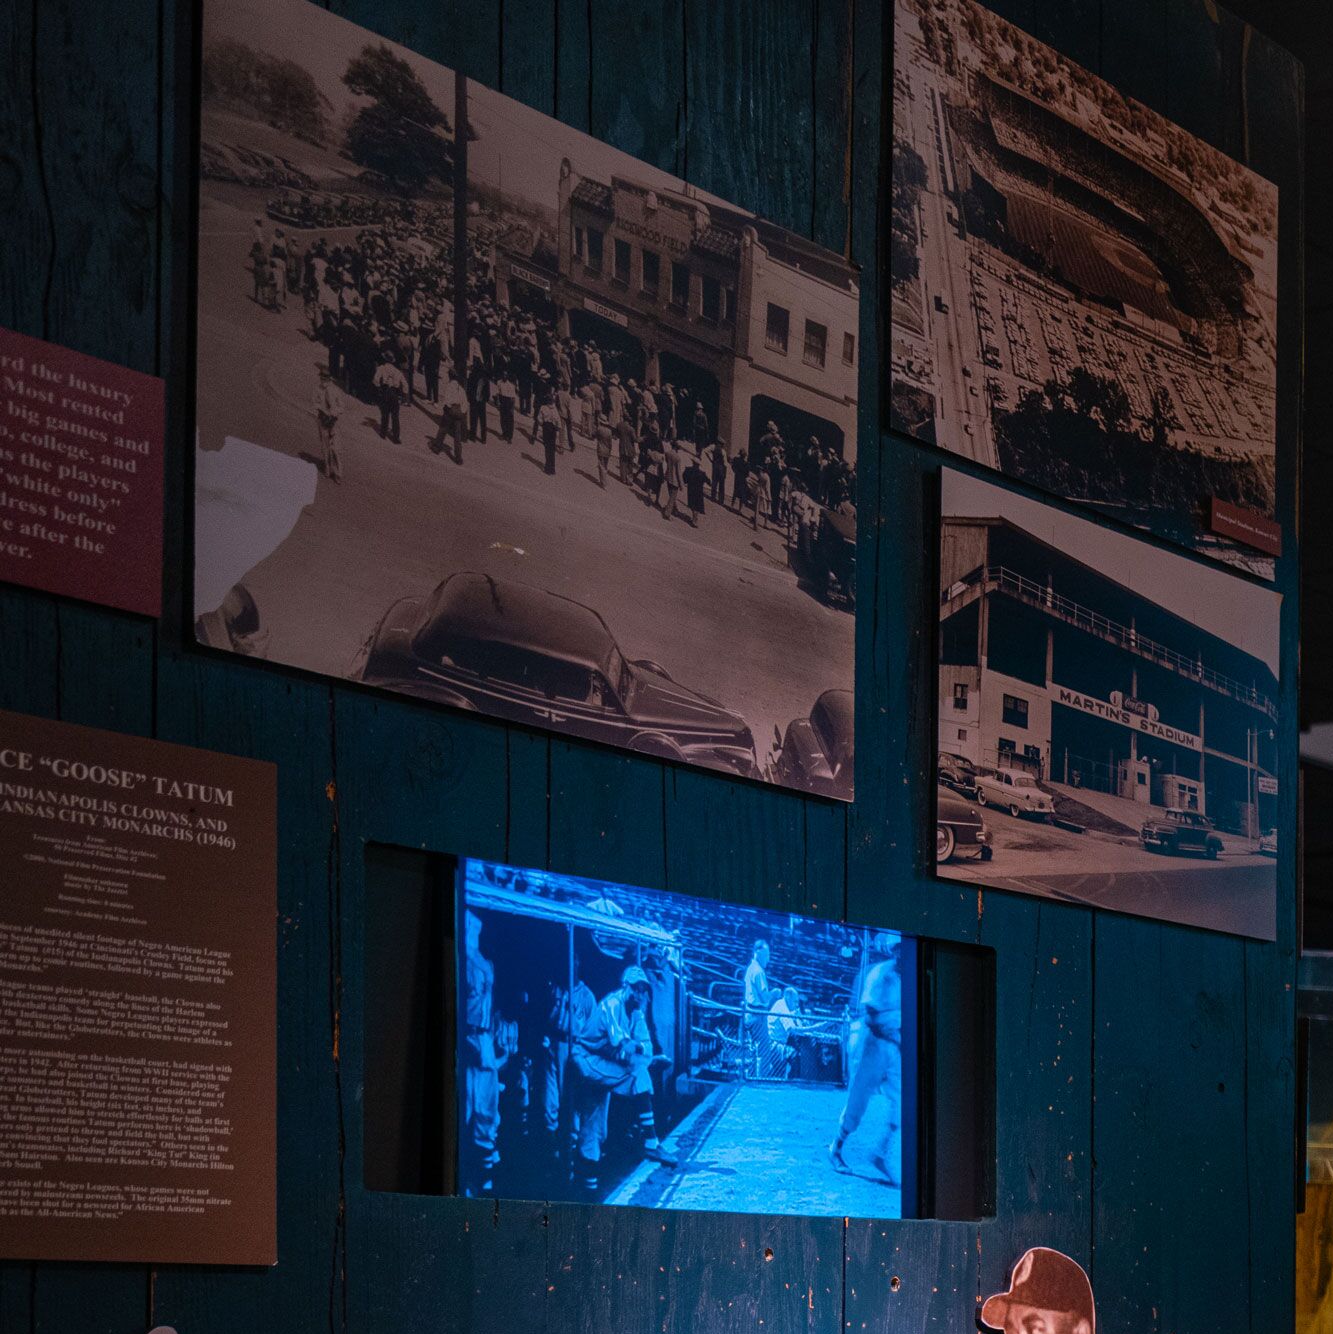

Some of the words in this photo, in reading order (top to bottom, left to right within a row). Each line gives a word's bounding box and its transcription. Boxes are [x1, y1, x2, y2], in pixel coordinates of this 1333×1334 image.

[594, 305, 618, 319] TODAY
[5, 377, 53, 403] Most
[62, 398, 123, 423] rented
[32, 364, 61, 382] the
[69, 374, 132, 406] luxury
[8, 400, 38, 424] big
[46, 416, 107, 441] games
[114, 437, 149, 454] and
[21, 432, 93, 461] college,
[101, 455, 136, 472] and
[21, 453, 50, 471] the
[58, 465, 129, 492] players
[20, 524, 68, 543] after
[74, 536, 104, 553] the
[54, 506, 115, 533] before
[1060, 689, 1130, 724] MARTIN'S
[1140, 720, 1195, 747] STADIUM
[39, 758, 146, 788] “GOOSE”
[152, 777, 233, 805] TATUM
[0, 801, 54, 818] ANSAS
[58, 809, 97, 824] CITY
[103, 816, 193, 840] MONARCHS
[196, 833, 236, 849] (1946)
[120, 804, 192, 825] CLOWNS,
[196, 818, 227, 831] AND
